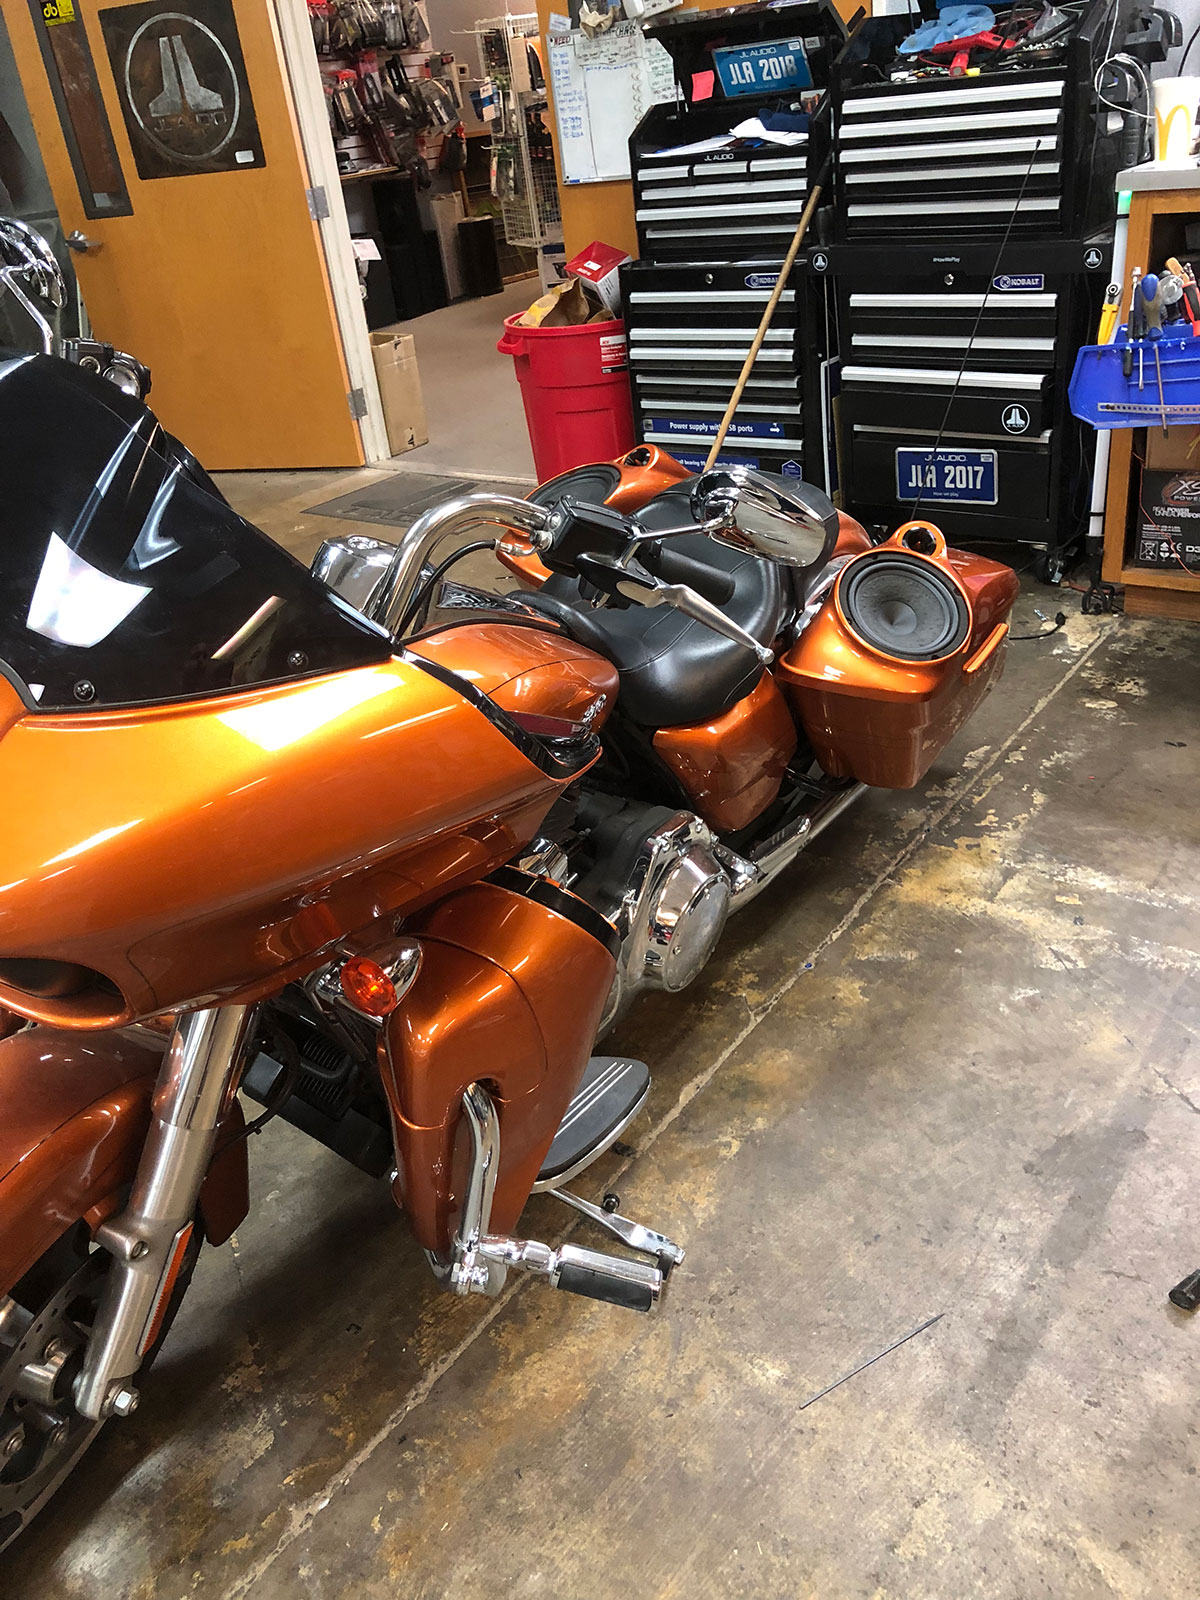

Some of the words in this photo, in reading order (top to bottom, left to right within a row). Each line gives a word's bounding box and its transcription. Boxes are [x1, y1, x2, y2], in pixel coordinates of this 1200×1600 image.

[750, 46, 777, 57] AUDIO
[728, 61, 756, 85] JLA
[758, 54, 798, 81] 2018
[713, 152, 735, 161] AUDIO
[1010, 278, 1040, 286] KOBALT
[669, 421, 688, 430] Power
[689, 422, 708, 432] supply
[709, 423, 722, 431] wit
[737, 424, 754, 433] ports
[936, 454, 967, 462] AUDIO
[908, 464, 937, 488] JLA
[944, 465, 985, 490] 2017
